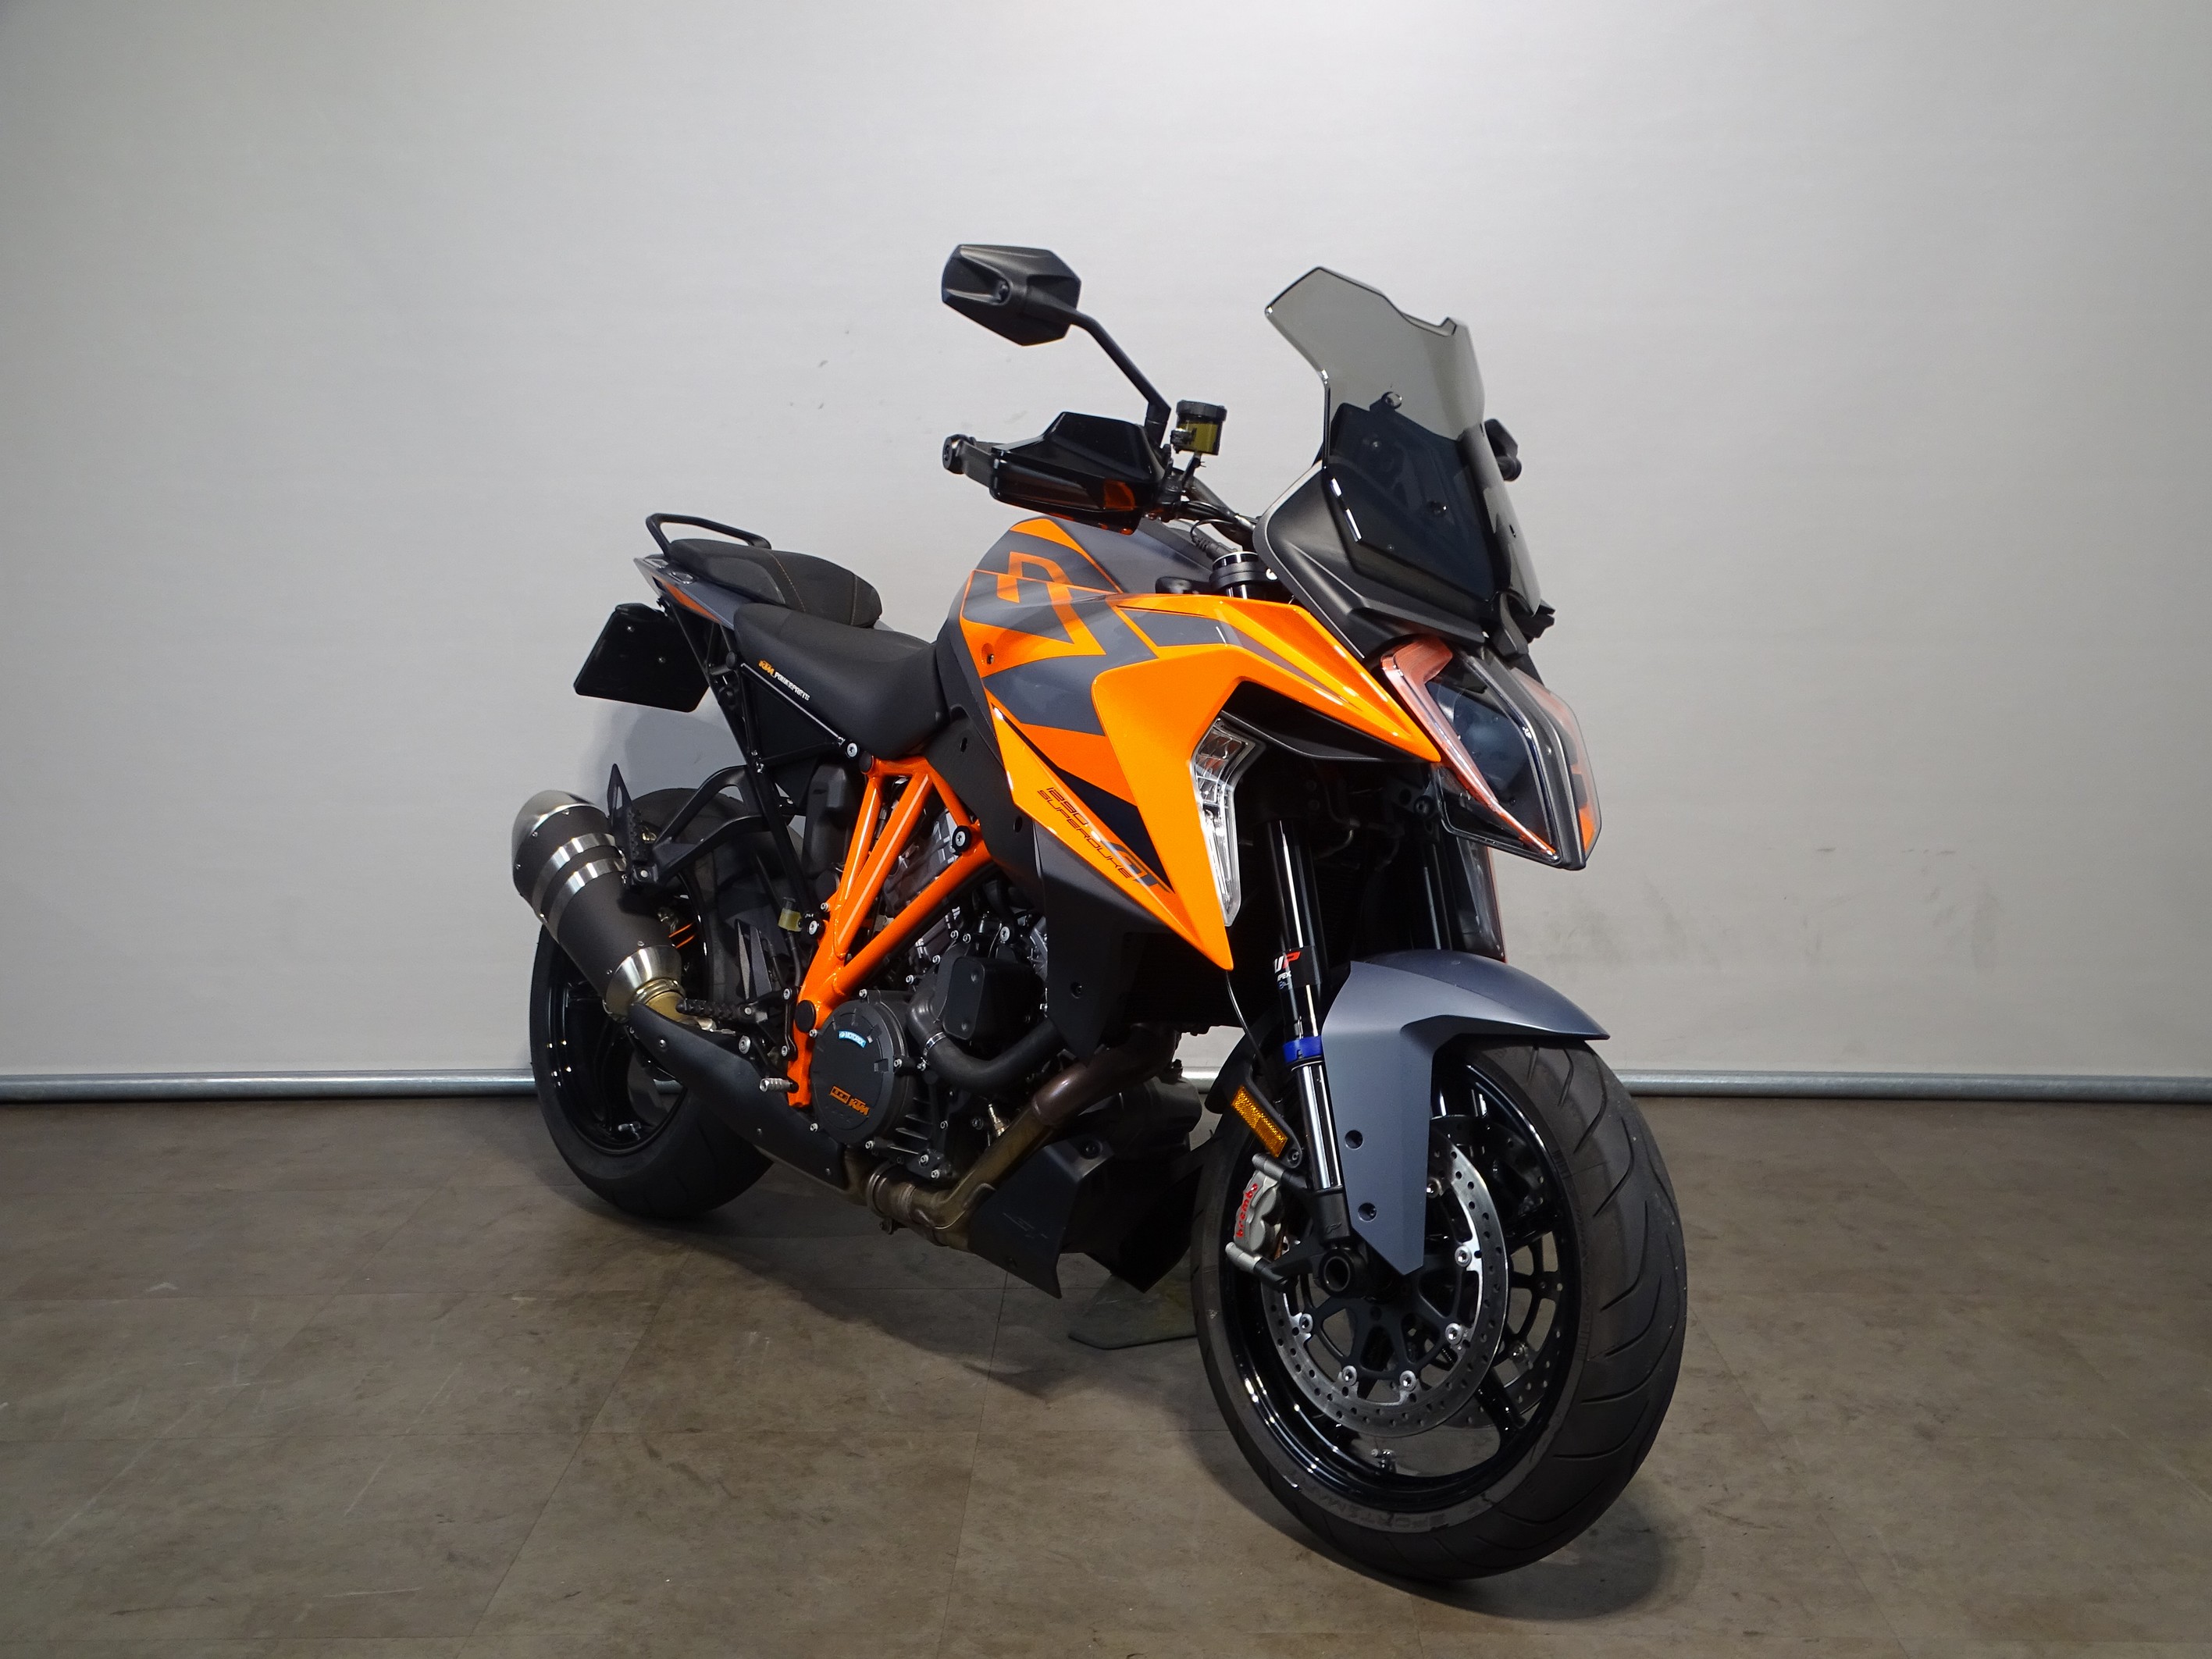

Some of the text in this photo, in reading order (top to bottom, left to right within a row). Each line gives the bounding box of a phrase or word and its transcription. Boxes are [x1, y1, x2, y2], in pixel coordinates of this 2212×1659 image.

[1046, 787, 1090, 826] 1290
[1037, 789, 1132, 879] SUPERDUKE
[849, 1098, 870, 1116] KTM
[1236, 1183, 1258, 1237] brembo
